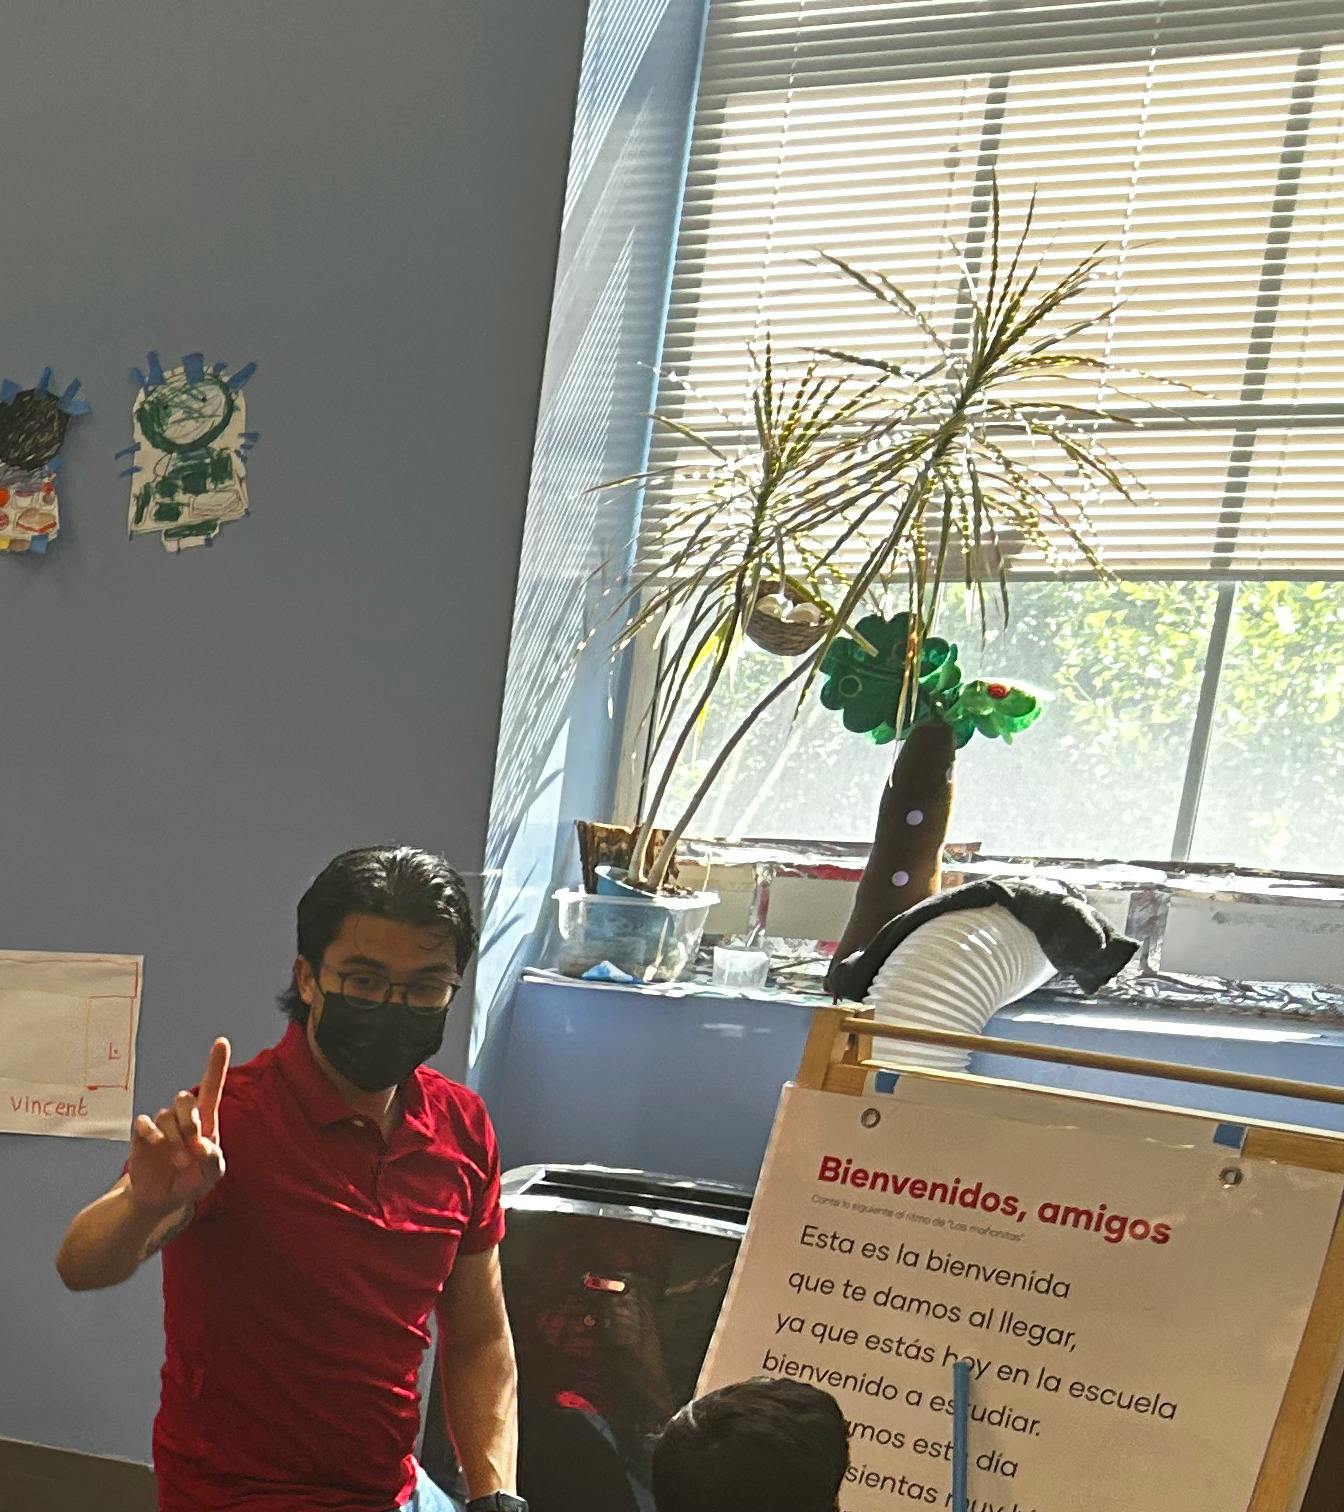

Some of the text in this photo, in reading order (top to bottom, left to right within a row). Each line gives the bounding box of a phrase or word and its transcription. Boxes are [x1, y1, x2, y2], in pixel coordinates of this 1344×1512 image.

[817, 1155, 1173, 1245] Bienvenidos, amigos
[800, 1224, 1071, 1300] Esta es la bienvenida
[788, 1271, 1078, 1354] que te damos al llegar,
[762, 1349, 899, 1403] bienvenido
[905, 1390, 923, 1408] a
[774, 1311, 806, 1335] ya
[811, 1320, 859, 1346] que
[864, 1332, 936, 1365] estás
[997, 1363, 1030, 1387] en
[1036, 1367, 1062, 1394] la
[1068, 1377, 1179, 1421] escuela
[845, 1463, 939, 1505] sientas
[912, 1436, 968, 1463] est
[975, 1449, 1020, 1479] día
